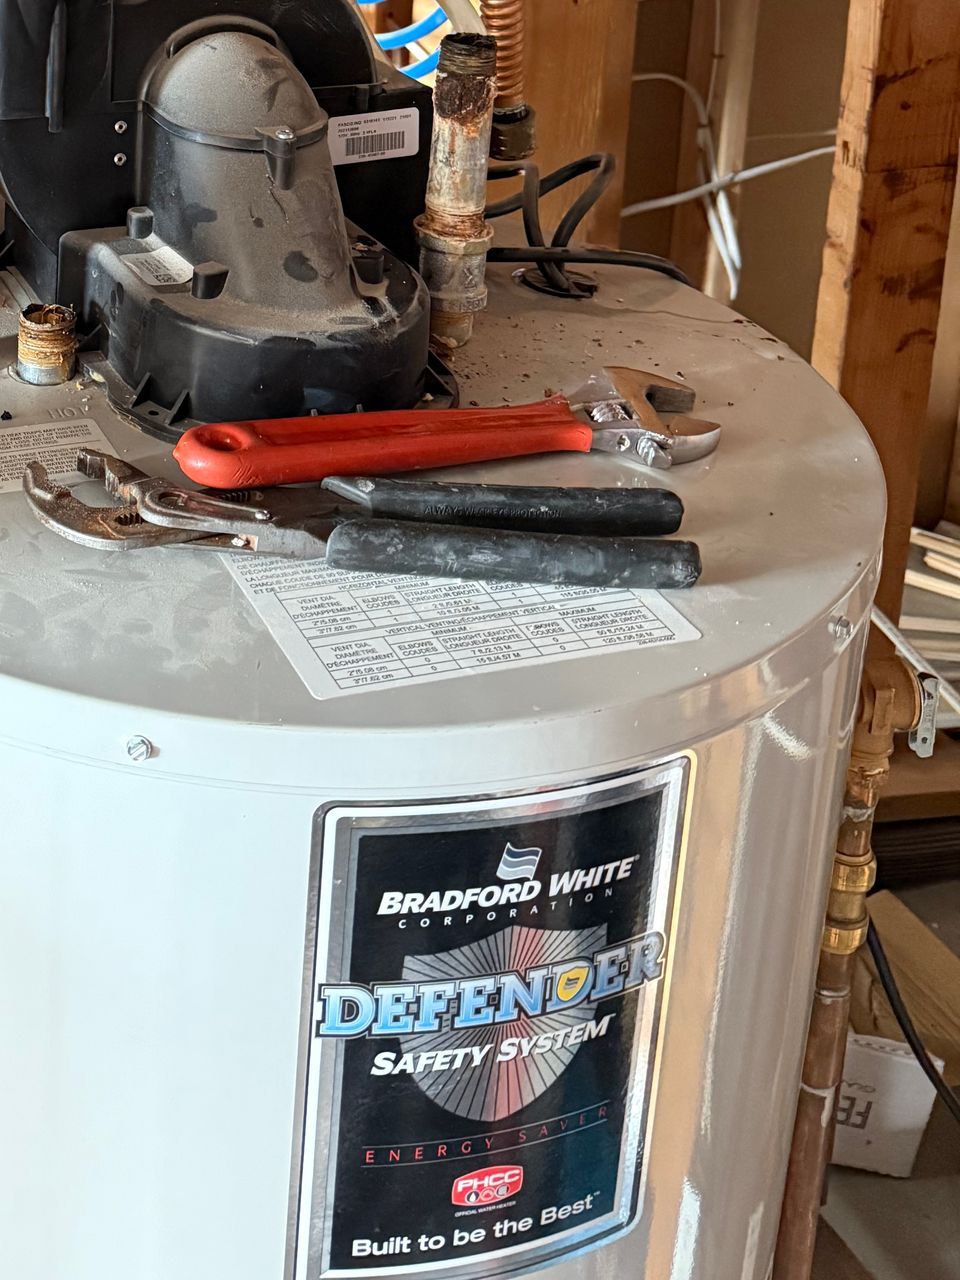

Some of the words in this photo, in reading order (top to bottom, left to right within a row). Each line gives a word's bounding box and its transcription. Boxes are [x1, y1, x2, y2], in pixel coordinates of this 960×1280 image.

[425, 504, 462, 516] ALWAYS
[511, 506, 563, 518] PROTECTION
[297, 597, 320, 605] VENT
[362, 594, 396, 604] ELBOWS
[404, 588, 444, 598] STRAIGHT
[445, 583, 476, 592] LENGTH
[366, 600, 400, 609] COUDES
[407, 592, 452, 604] LONGUEUR
[452, 588, 482, 597] DROITE
[394, 581, 430, 590] MINIMUM
[330, 644, 353, 653] VENT
[398, 640, 434, 651] ELBOWS
[441, 632, 482, 644] STRAIGHT
[482, 627, 516, 637] LENGTH
[571, 613, 610, 624] STRAIGHT
[610, 608, 643, 618] LENGTH
[385, 623, 425, 635] VERTICAL
[519, 604, 556, 614] VERTICAL
[402, 646, 438, 657] COUDES
[445, 637, 491, 650] LONGUEUR
[491, 633, 523, 643] DROITE
[530, 627, 565, 636] COUDES
[575, 619, 619, 630] LONGUEUR
[620, 614, 649, 623] DROITE
[430, 625, 467, 636] MINIMUM
[558, 607, 598, 617] MAXIMUM
[377, 879, 543, 915] BRADFORD
[398, 888, 613, 929] CORPORATION
[315, 931, 667, 1038] DEFENDER
[370, 1042, 495, 1077] SAFETY
[365, 1137, 494, 1164] ENERGY
[519, 1106, 608, 1142] SAVER
[457, 1170, 520, 1192] PHCC
[454, 1209, 478, 1218] OFFICIAL
[478, 1204, 496, 1213] WATER
[496, 1200, 516, 1209] HEATER
[351, 1236, 411, 1257] Built
[418, 1233, 445, 1251] to
[453, 1226, 486, 1247] be
[493, 1217, 533, 1239] the
